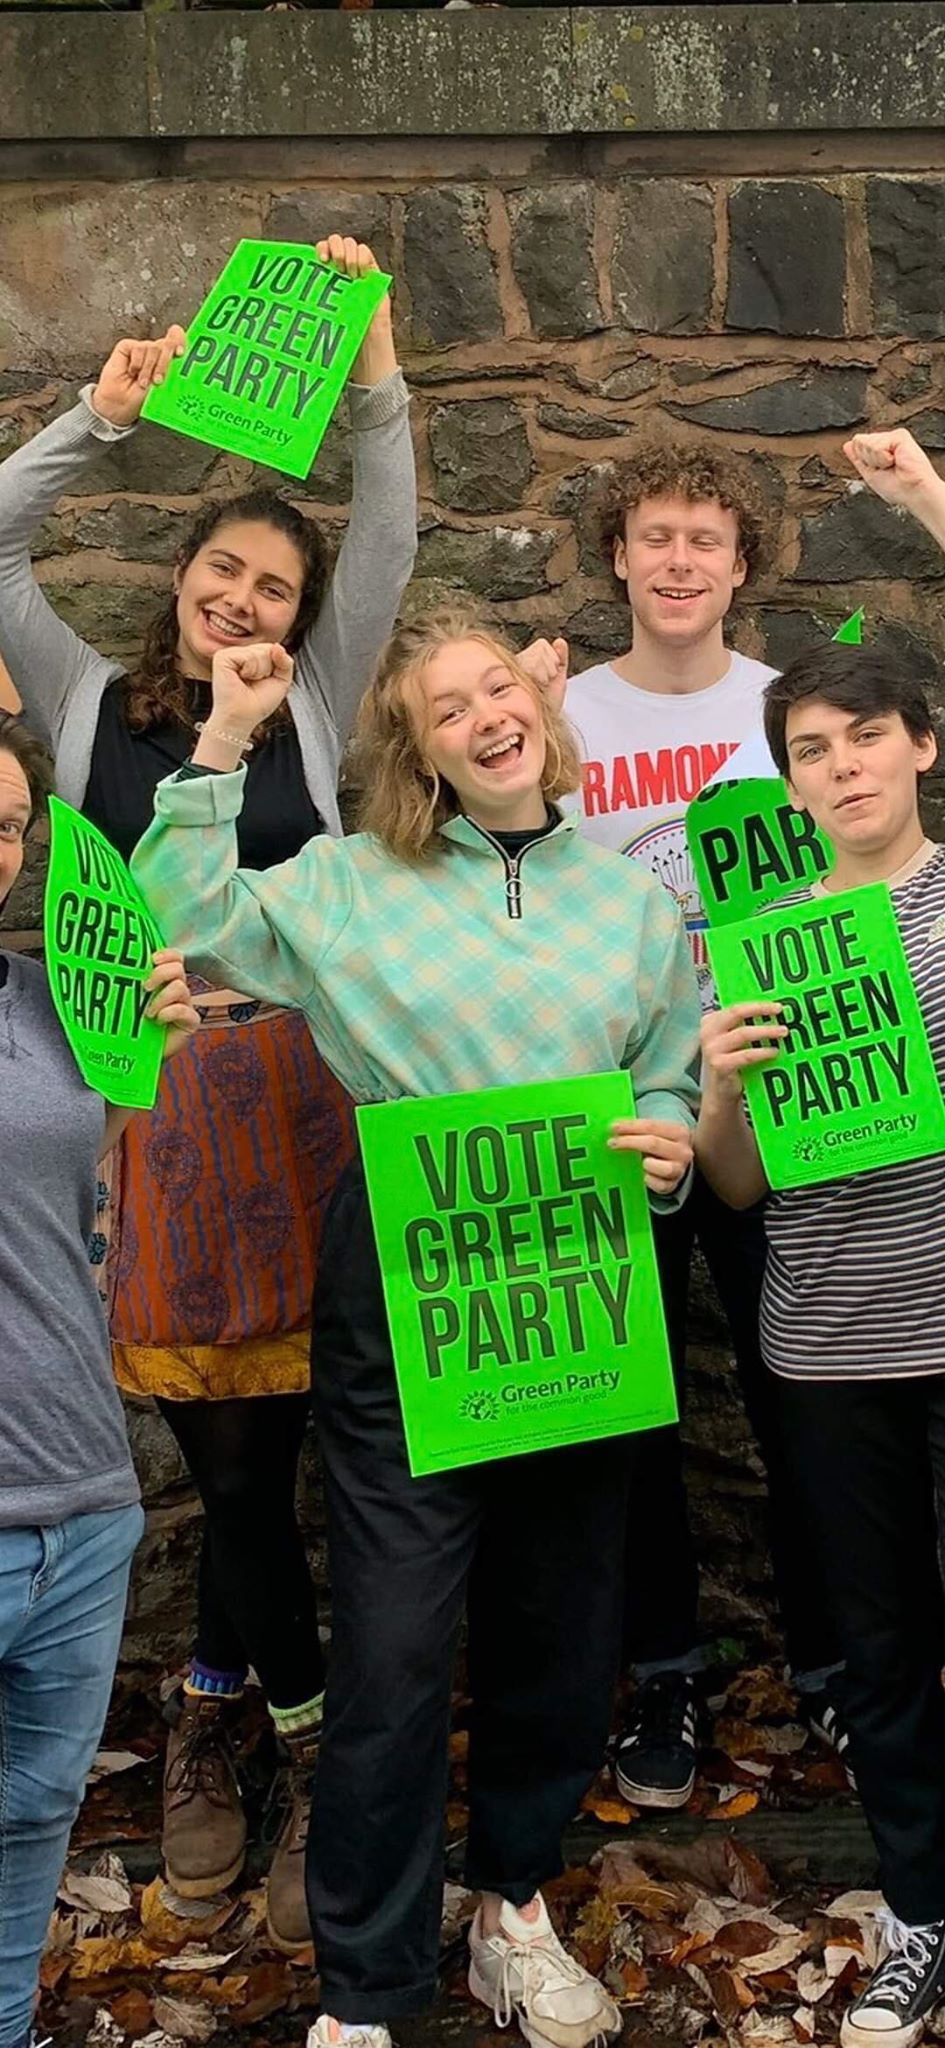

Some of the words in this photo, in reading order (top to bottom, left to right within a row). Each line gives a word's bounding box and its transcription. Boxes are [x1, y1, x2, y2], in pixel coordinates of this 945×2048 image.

[248, 255, 353, 312] VOTE
[206, 294, 346, 369] GREEN
[180, 335, 325, 419] PARTY
[208, 404, 251, 430] Green
[253, 420, 293, 446] Party
[581, 743, 741, 817] RAMON
[742, 910, 867, 992] VOTE
[106, 1050, 136, 1075] Party
[763, 1035, 909, 1128] PARTY
[413, 1113, 595, 1212] VOTE
[823, 1124, 872, 1147] Green
[874, 1113, 917, 1134] Party
[404, 1186, 629, 1293] GREEN
[418, 1264, 635, 1380] PARTY
[501, 1380, 562, 1403] Green
[566, 1370, 620, 1392] Party
